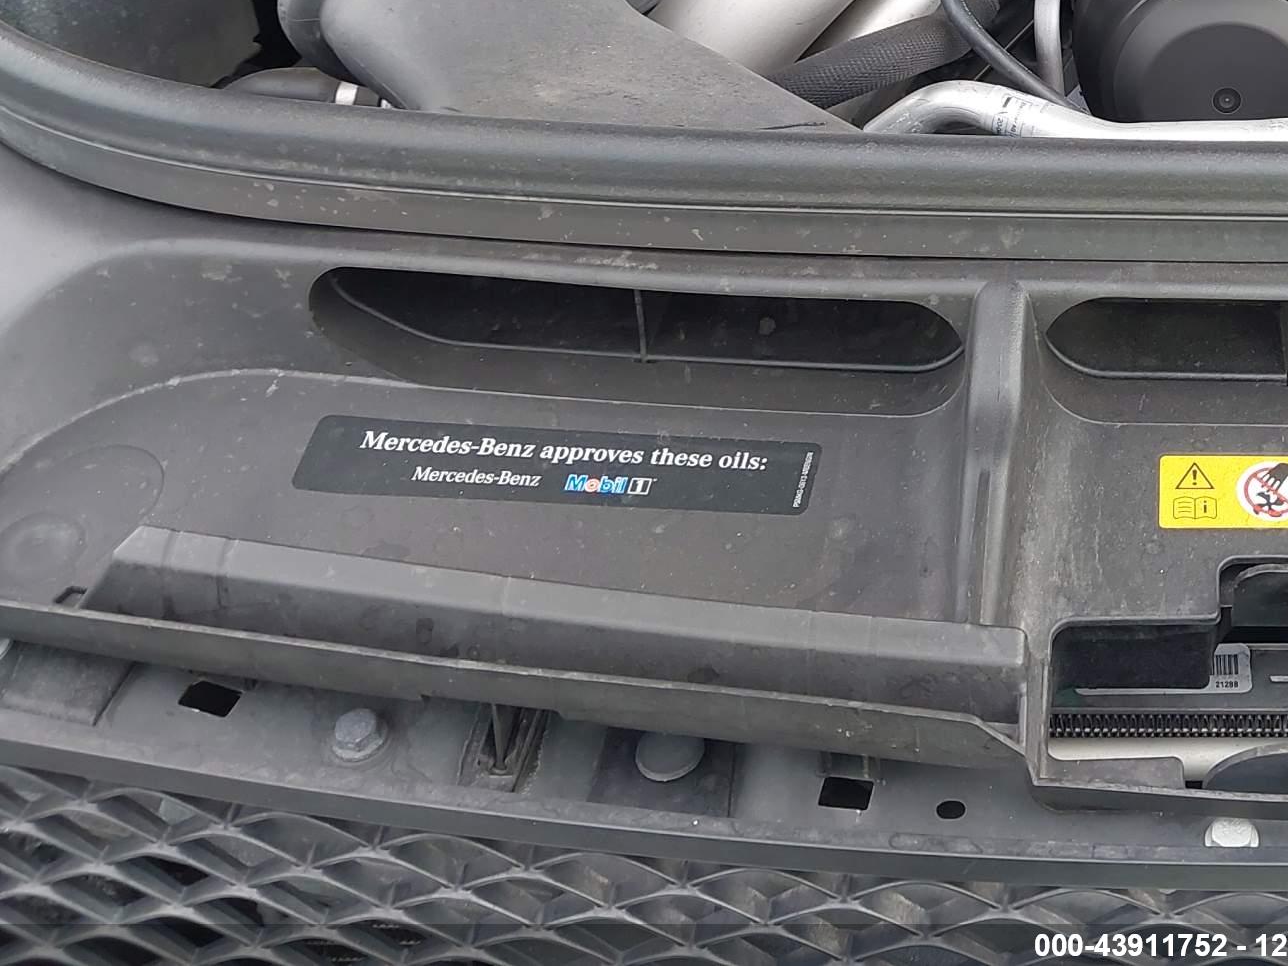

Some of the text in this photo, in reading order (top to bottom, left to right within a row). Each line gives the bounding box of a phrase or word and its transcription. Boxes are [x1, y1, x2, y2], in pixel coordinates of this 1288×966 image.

[360, 431, 768, 471] Mercedes-Benz approves these oils:
[411, 466, 542, 487] Mercedes-Benz
[564, 474, 628, 495] Mobil
